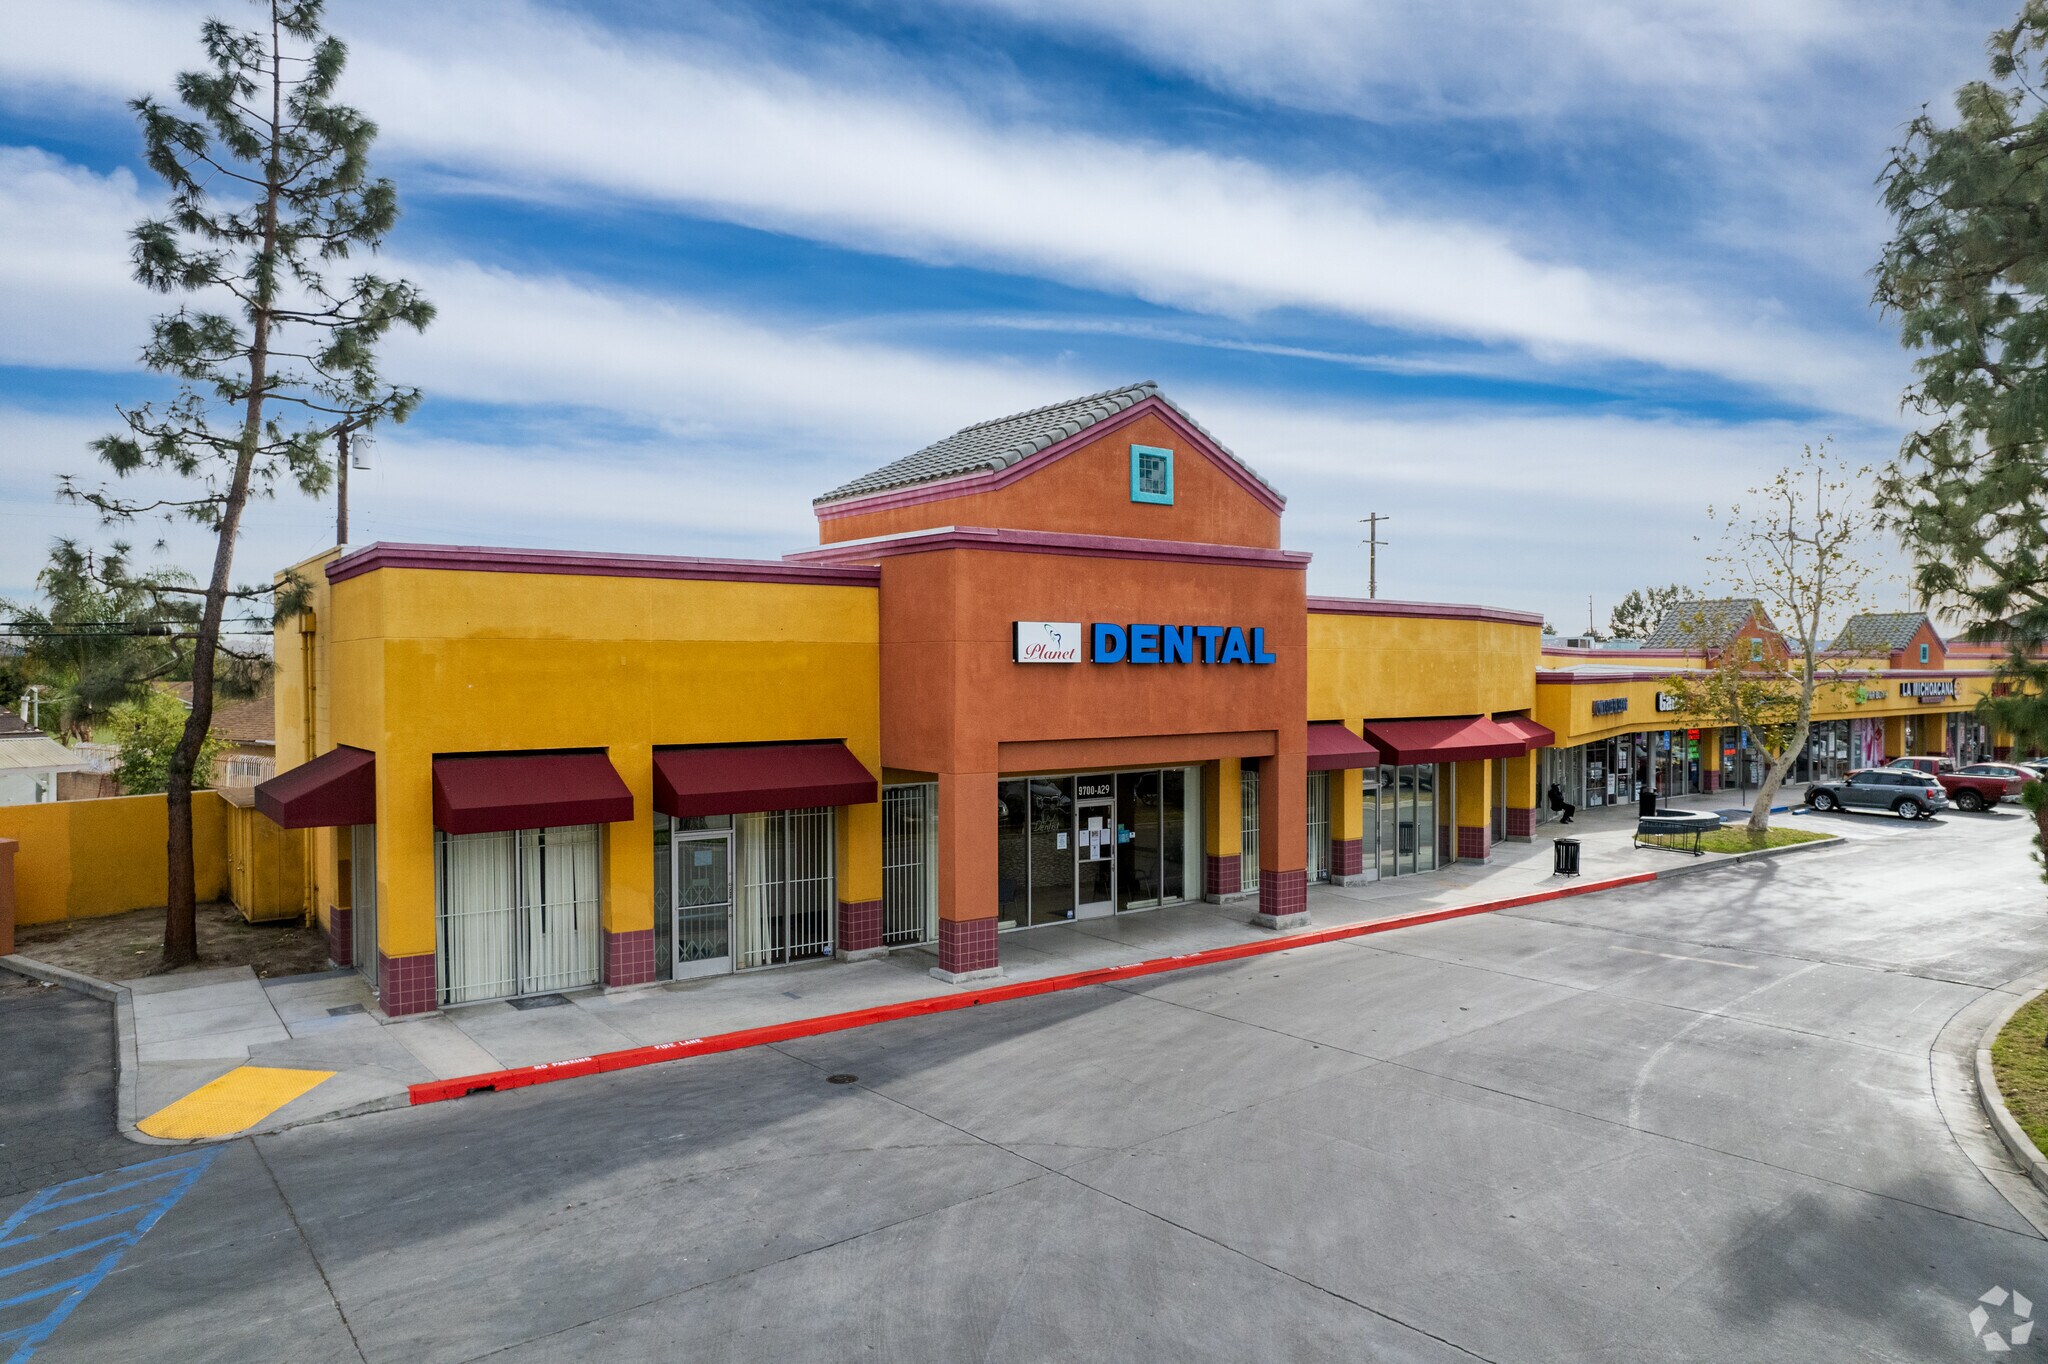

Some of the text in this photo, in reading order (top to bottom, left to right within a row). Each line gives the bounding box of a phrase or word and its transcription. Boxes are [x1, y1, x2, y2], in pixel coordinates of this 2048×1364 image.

[1023, 622, 1277, 664] Planet DENTAL
[1902, 683, 1912, 696] LA
[1912, 682, 1954, 696] MICHOACANA
[1078, 784, 1110, 796] 9700-A29
[552, 1056, 592, 1067] PARKING
[654, 1042, 677, 1050] FIRE
[679, 1038, 703, 1046] LANE
